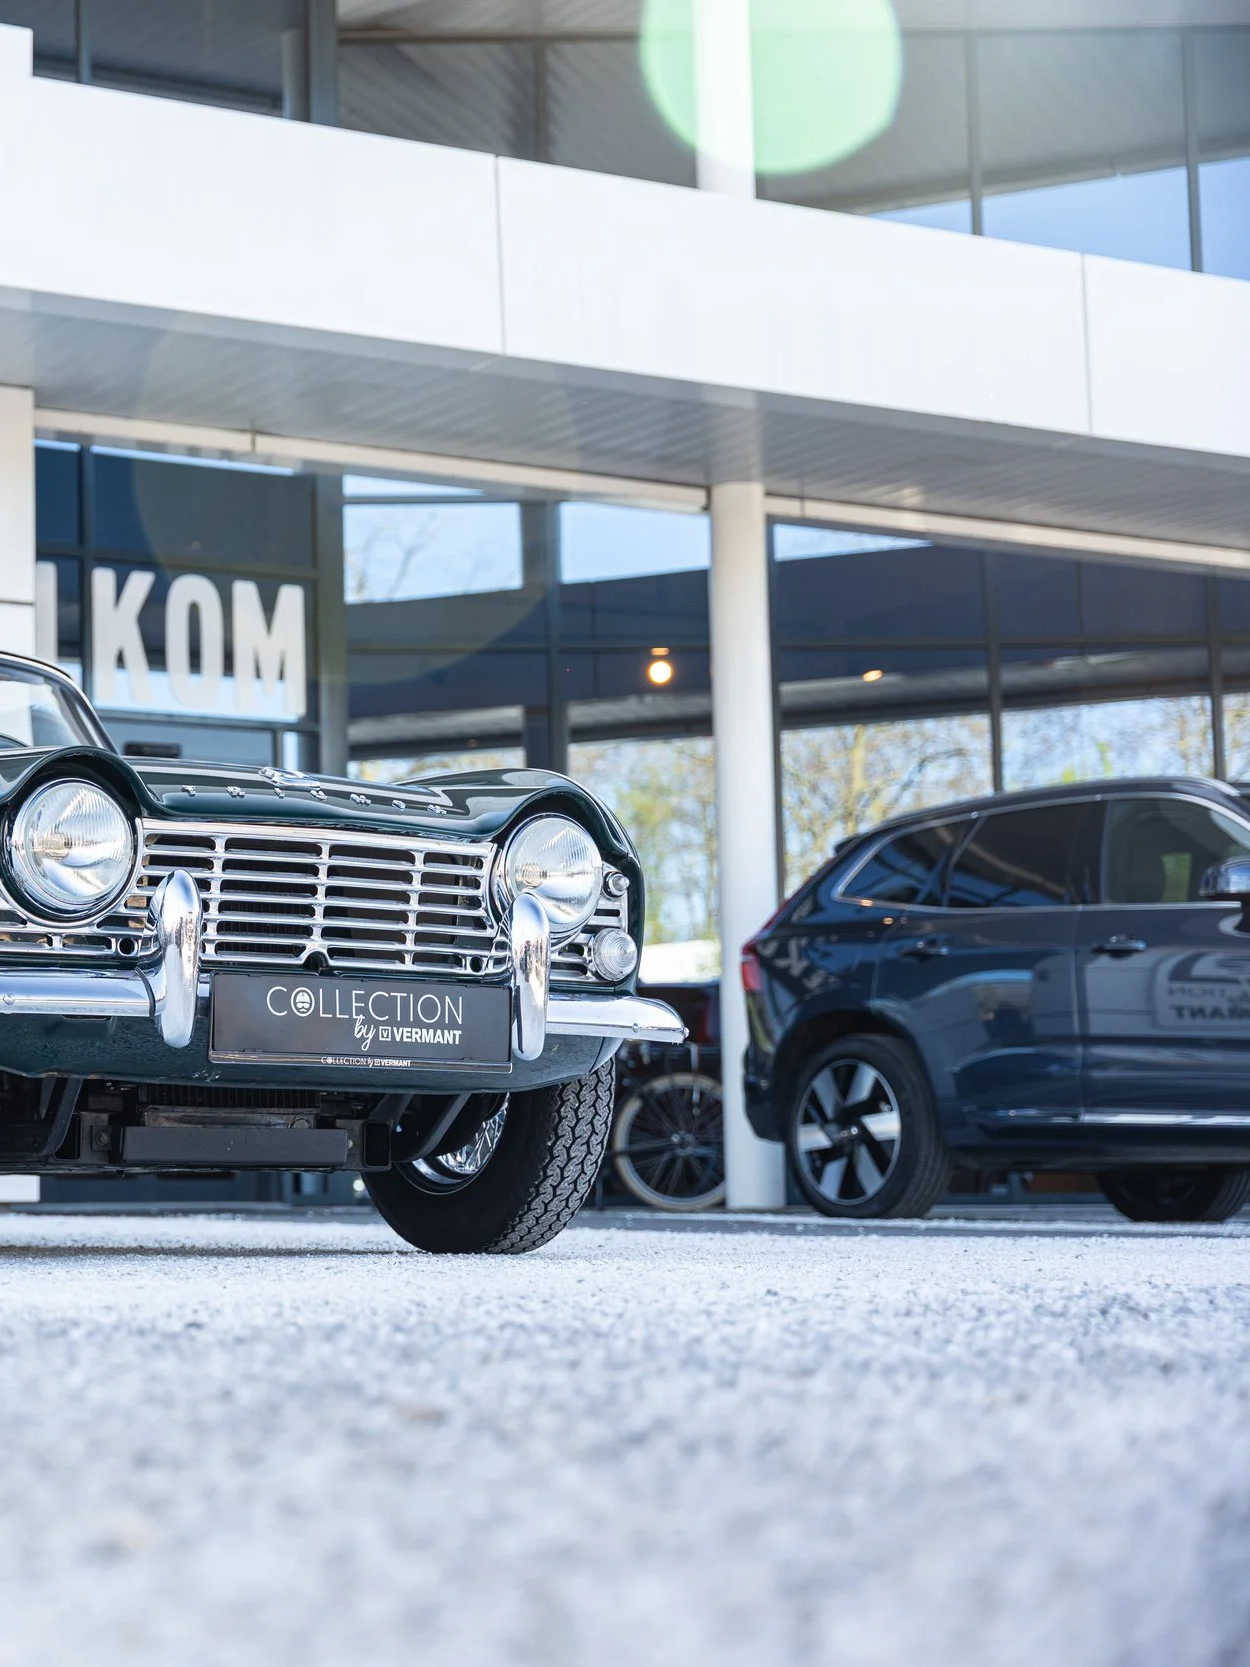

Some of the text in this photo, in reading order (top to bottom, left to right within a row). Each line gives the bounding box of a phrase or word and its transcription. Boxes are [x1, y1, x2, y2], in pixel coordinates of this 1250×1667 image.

[266, 985, 463, 1025] COLLECTION
[354, 1014, 376, 1051] by
[393, 1026, 462, 1045] VERMANT
[321, 1056, 366, 1065] COLLECTION
[380, 1059, 411, 1067] VERMANT
